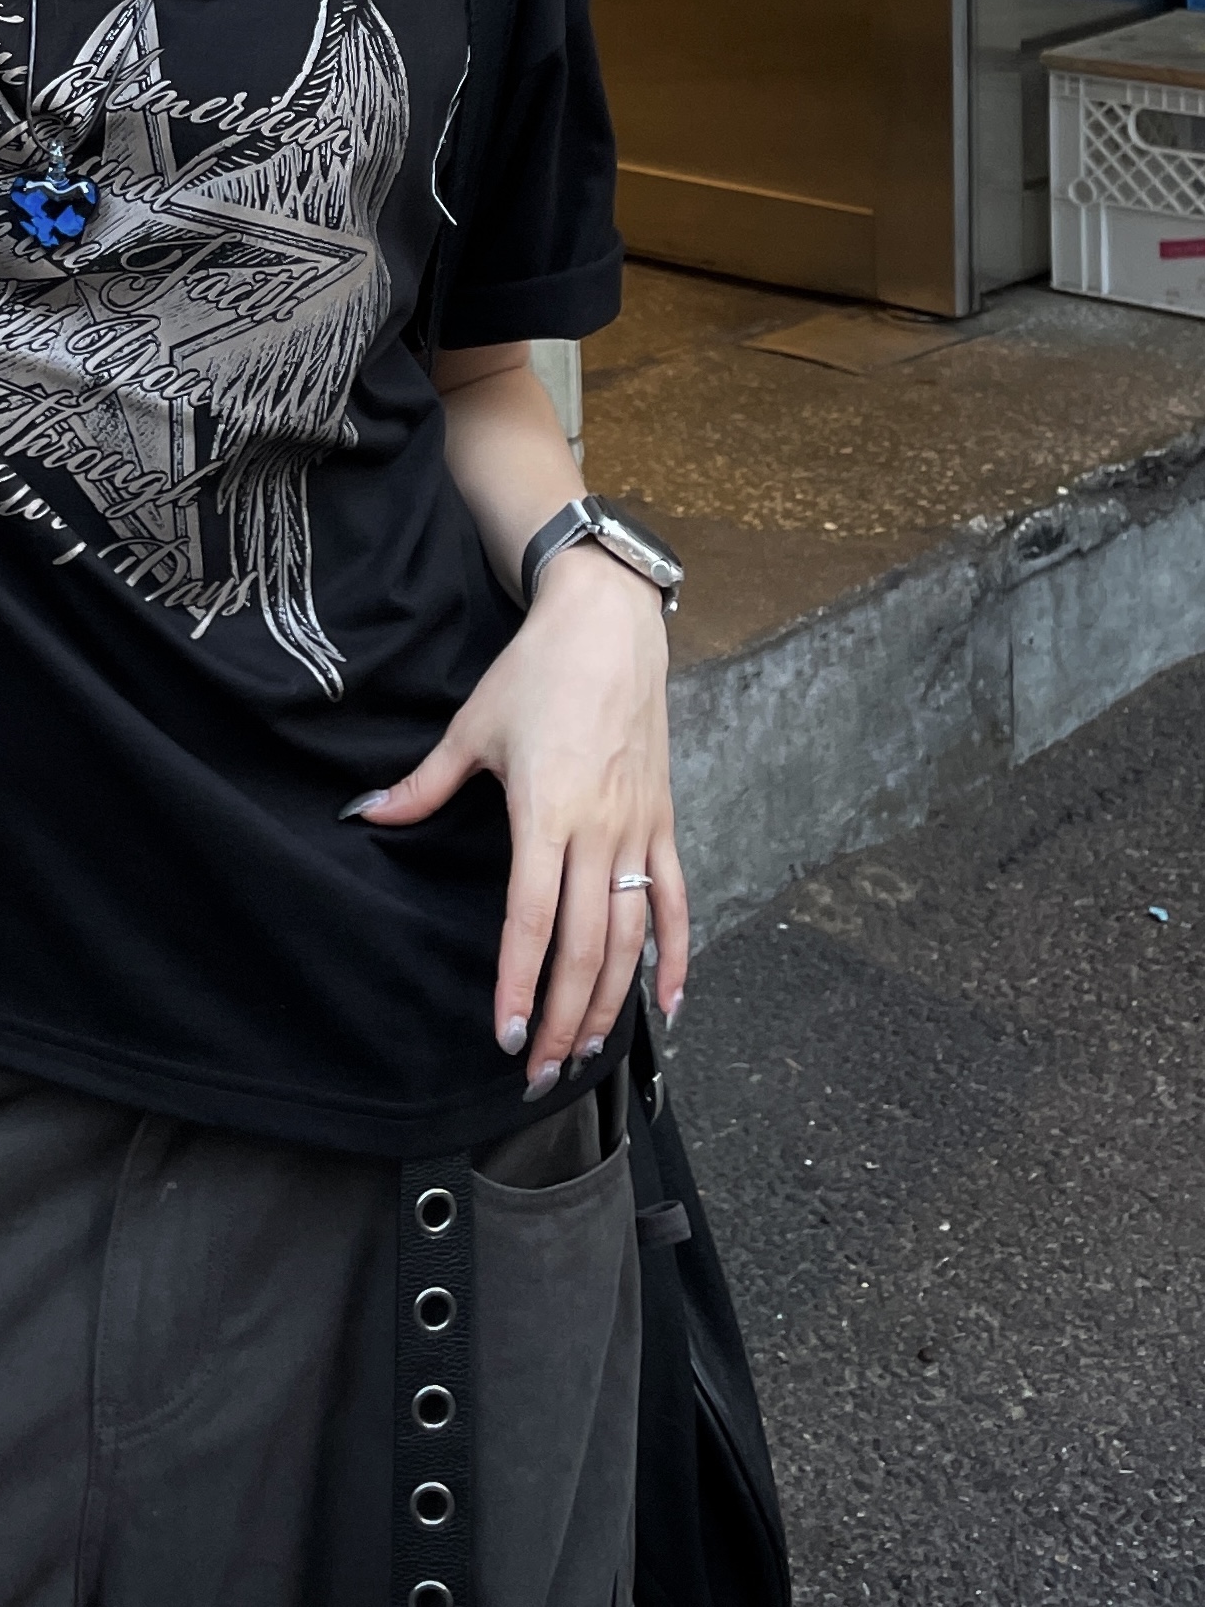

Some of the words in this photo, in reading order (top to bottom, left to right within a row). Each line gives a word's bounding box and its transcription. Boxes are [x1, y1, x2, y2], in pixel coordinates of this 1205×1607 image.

[33, 47, 355, 156] American
[104, 232, 303, 321] Faith
[67, 316, 213, 408] You
